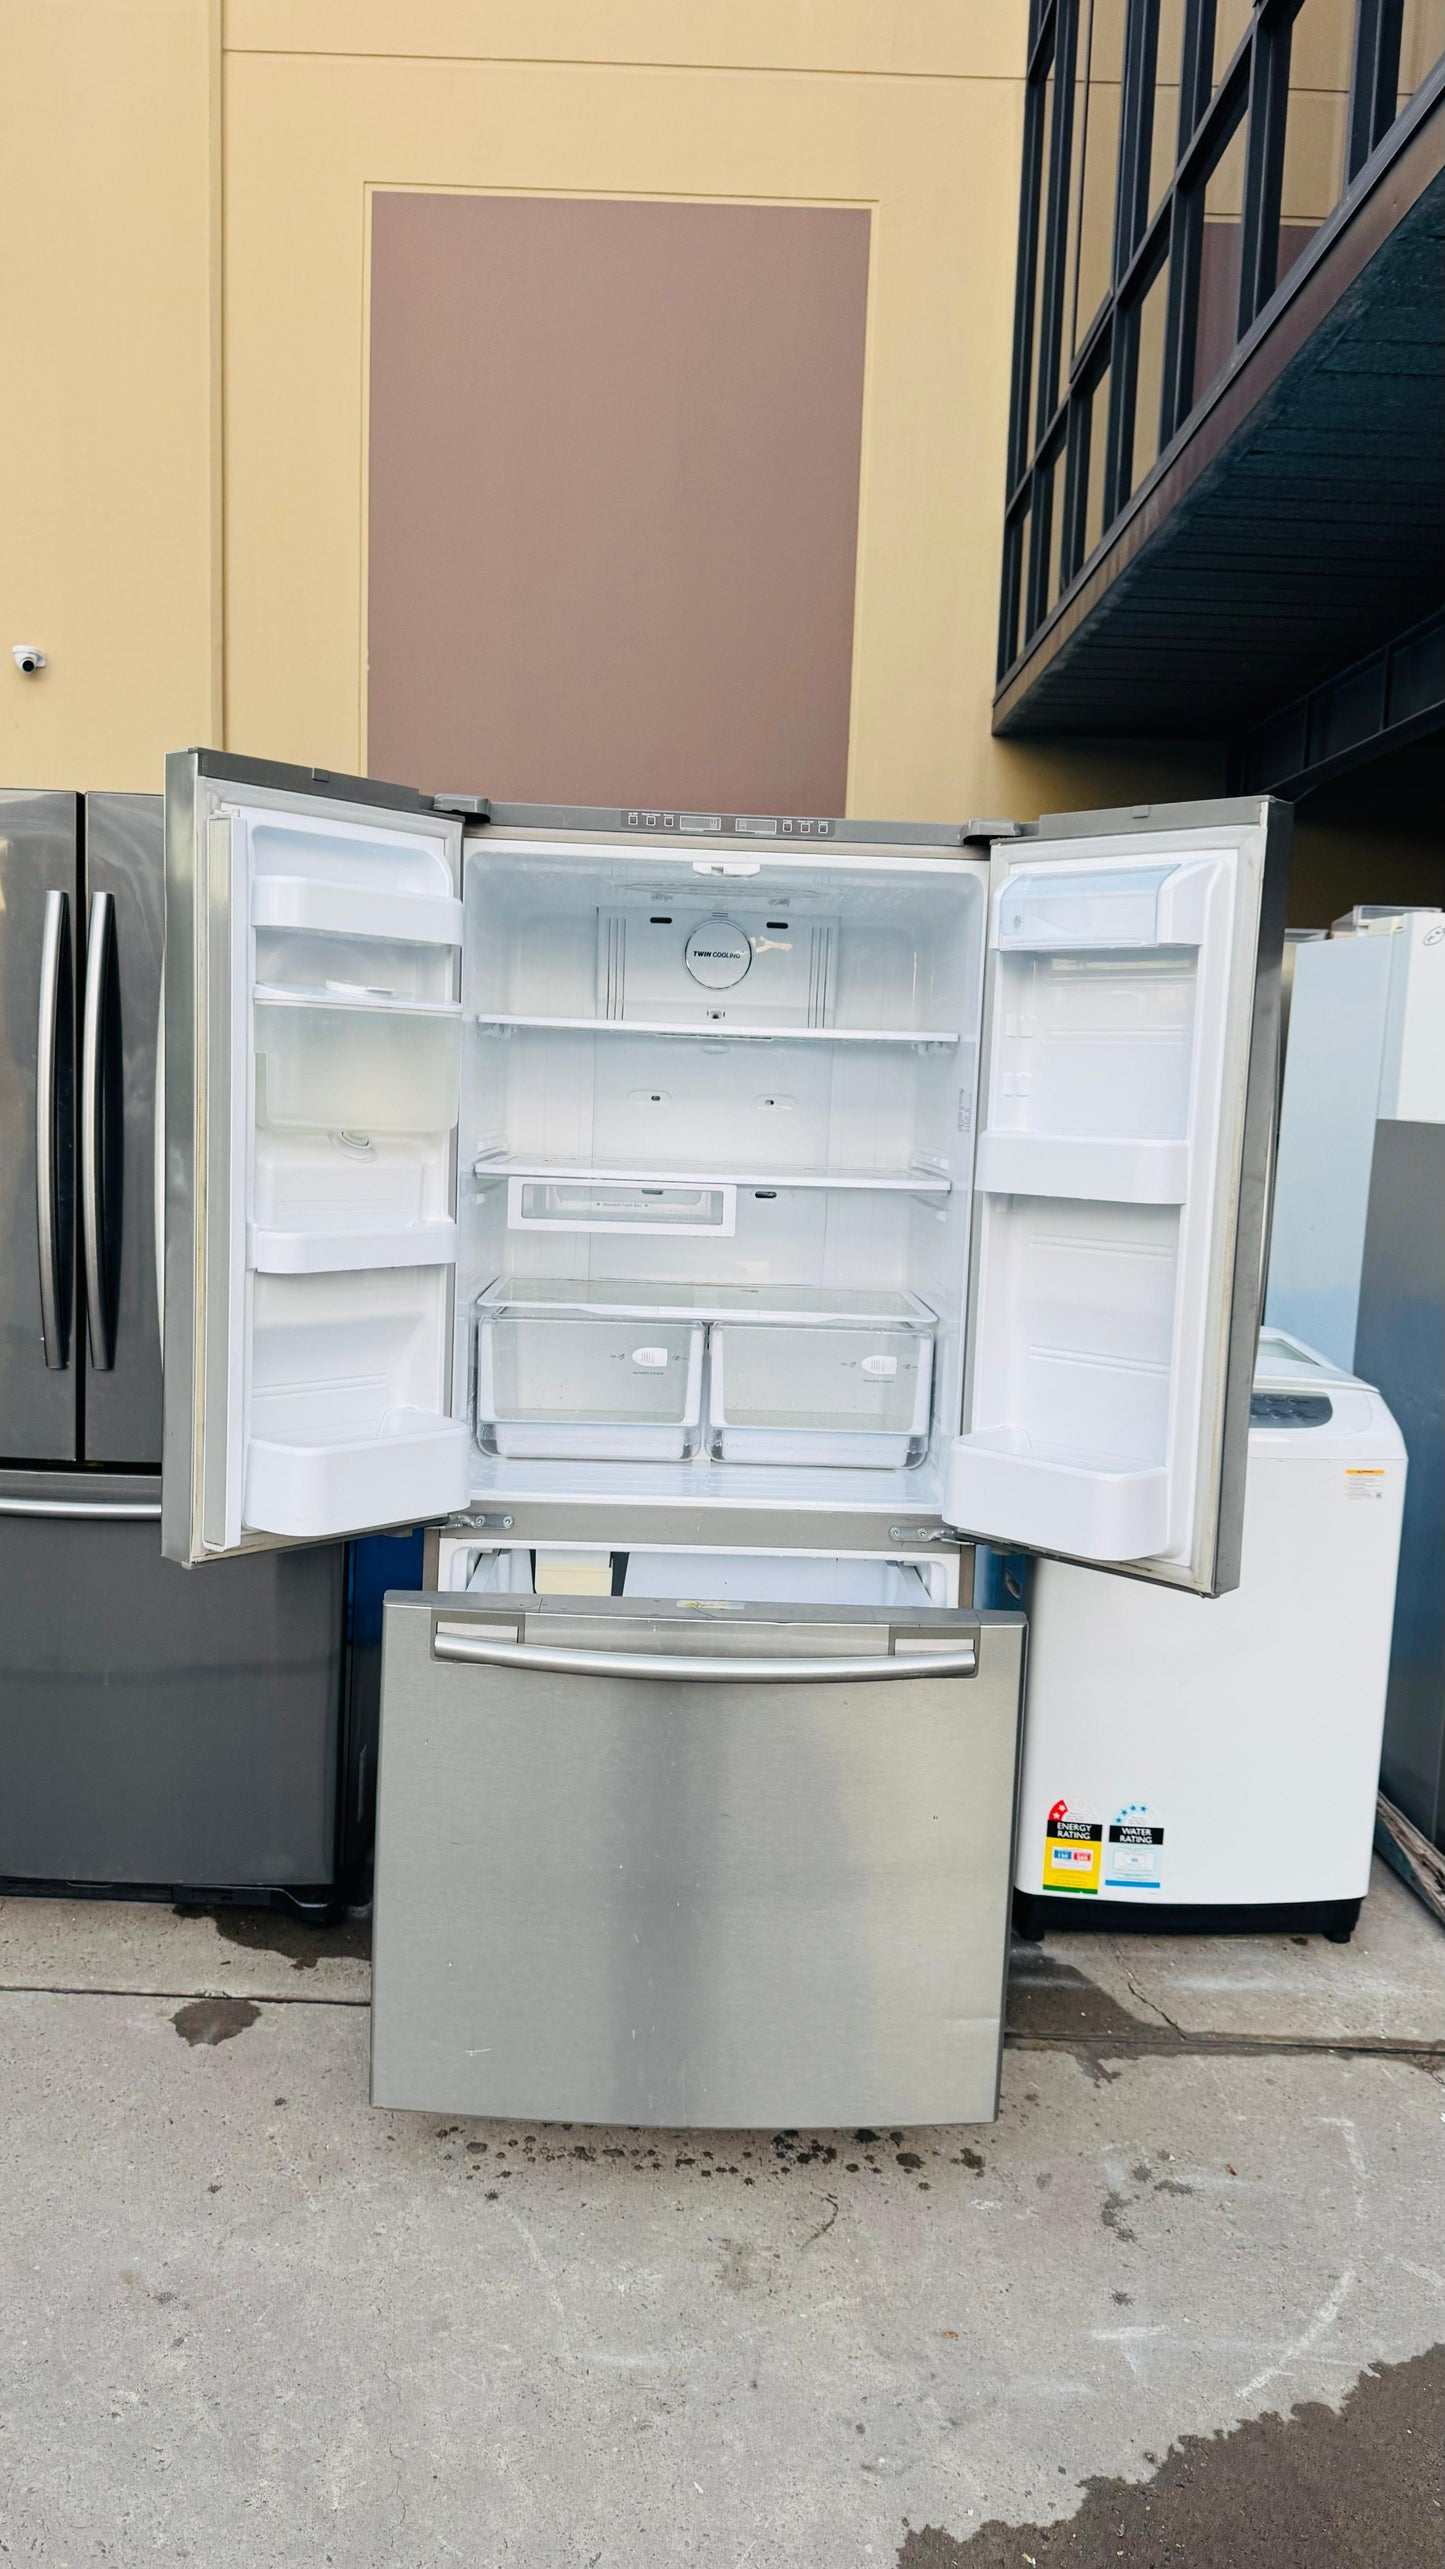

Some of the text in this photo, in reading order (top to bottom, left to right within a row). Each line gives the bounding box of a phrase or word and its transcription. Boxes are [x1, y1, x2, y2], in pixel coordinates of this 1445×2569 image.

[693, 950, 741, 959] TWIN COOLING
[1056, 1822, 1092, 1832] ENERGY
[1121, 1827, 1152, 1836] WATER
[1057, 1830, 1091, 1840] RATING
[1119, 1834, 1153, 1844] RATING
